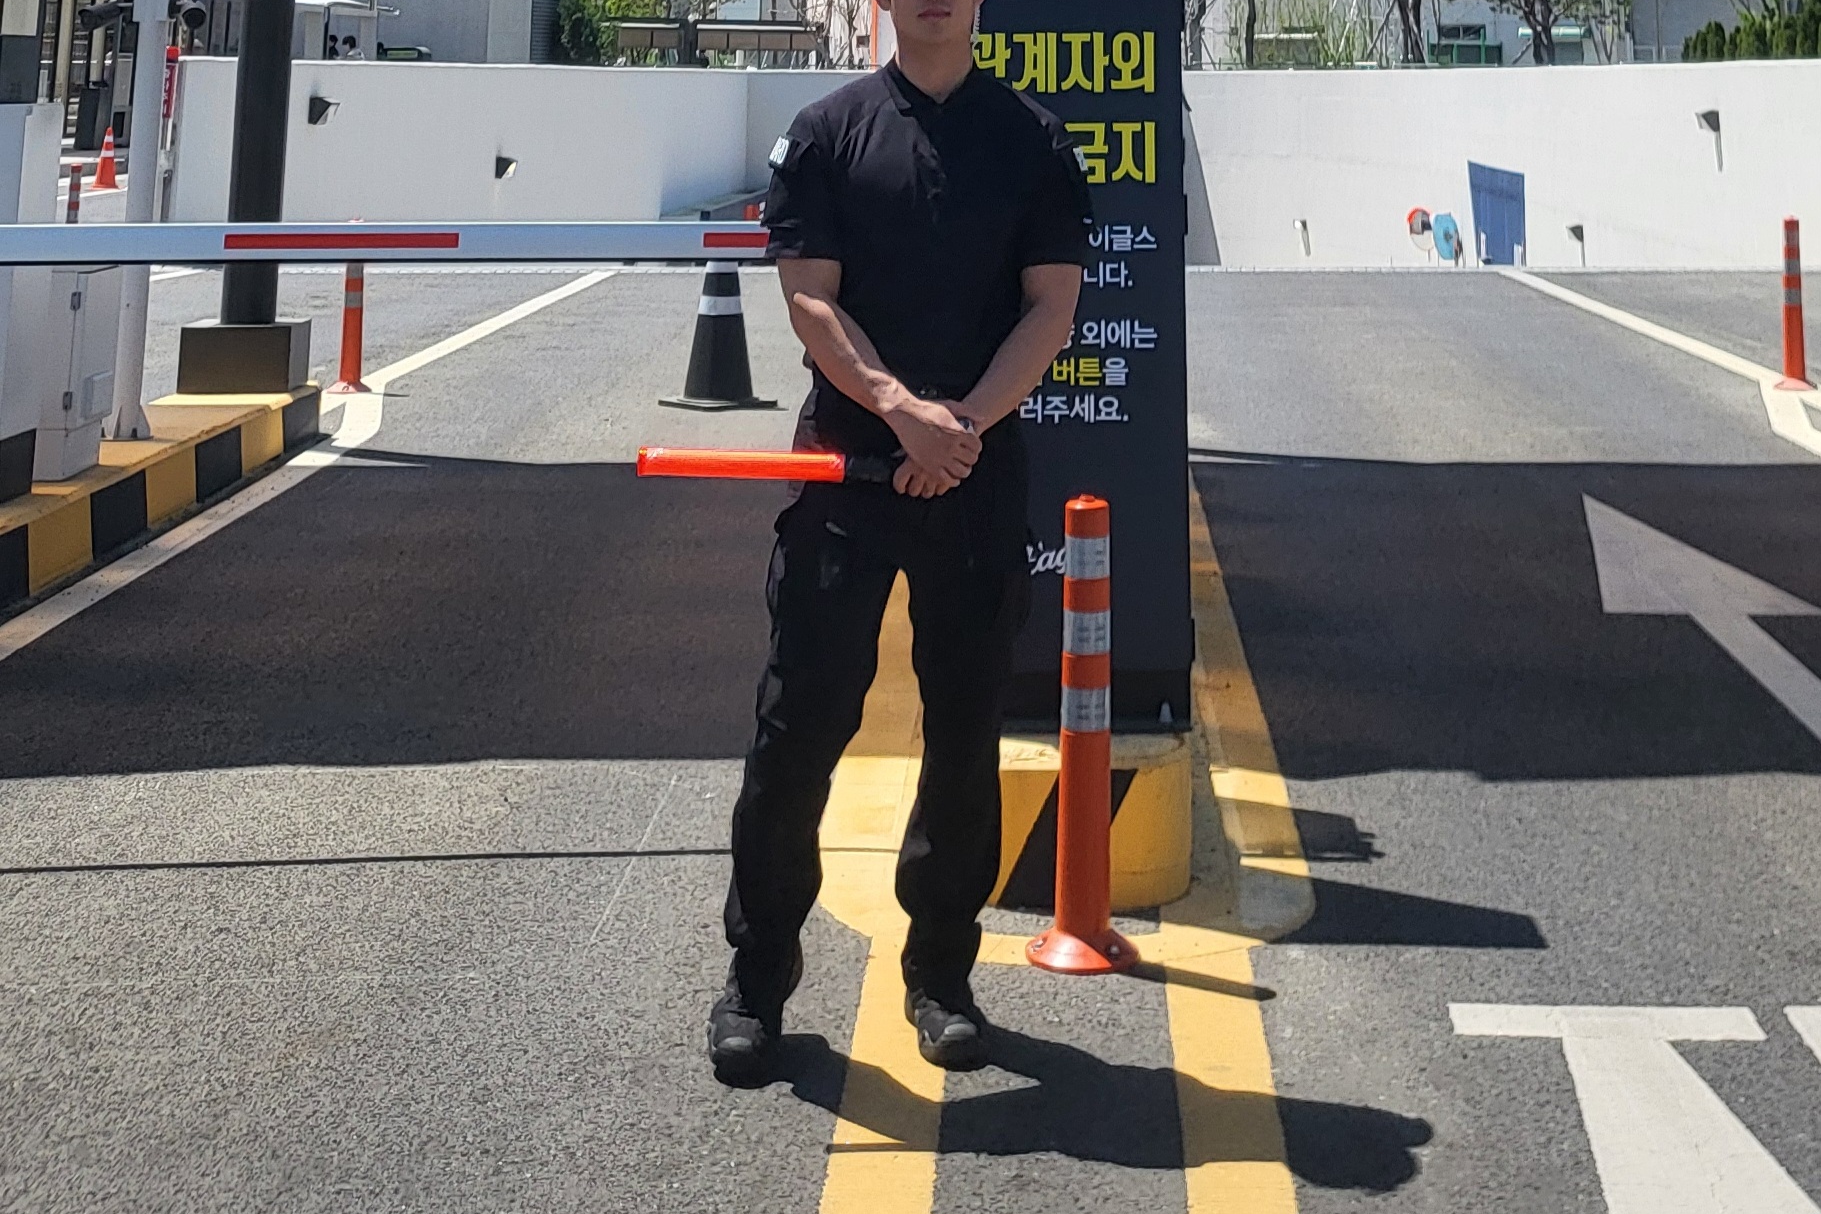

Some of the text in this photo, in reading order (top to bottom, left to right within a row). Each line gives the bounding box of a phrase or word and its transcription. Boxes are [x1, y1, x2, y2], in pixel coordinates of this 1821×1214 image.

[1080, 318, 1158, 349] 외에는
[1052, 356, 1129, 386] 버튼을
[1017, 392, 1129, 424] 러주세요.
